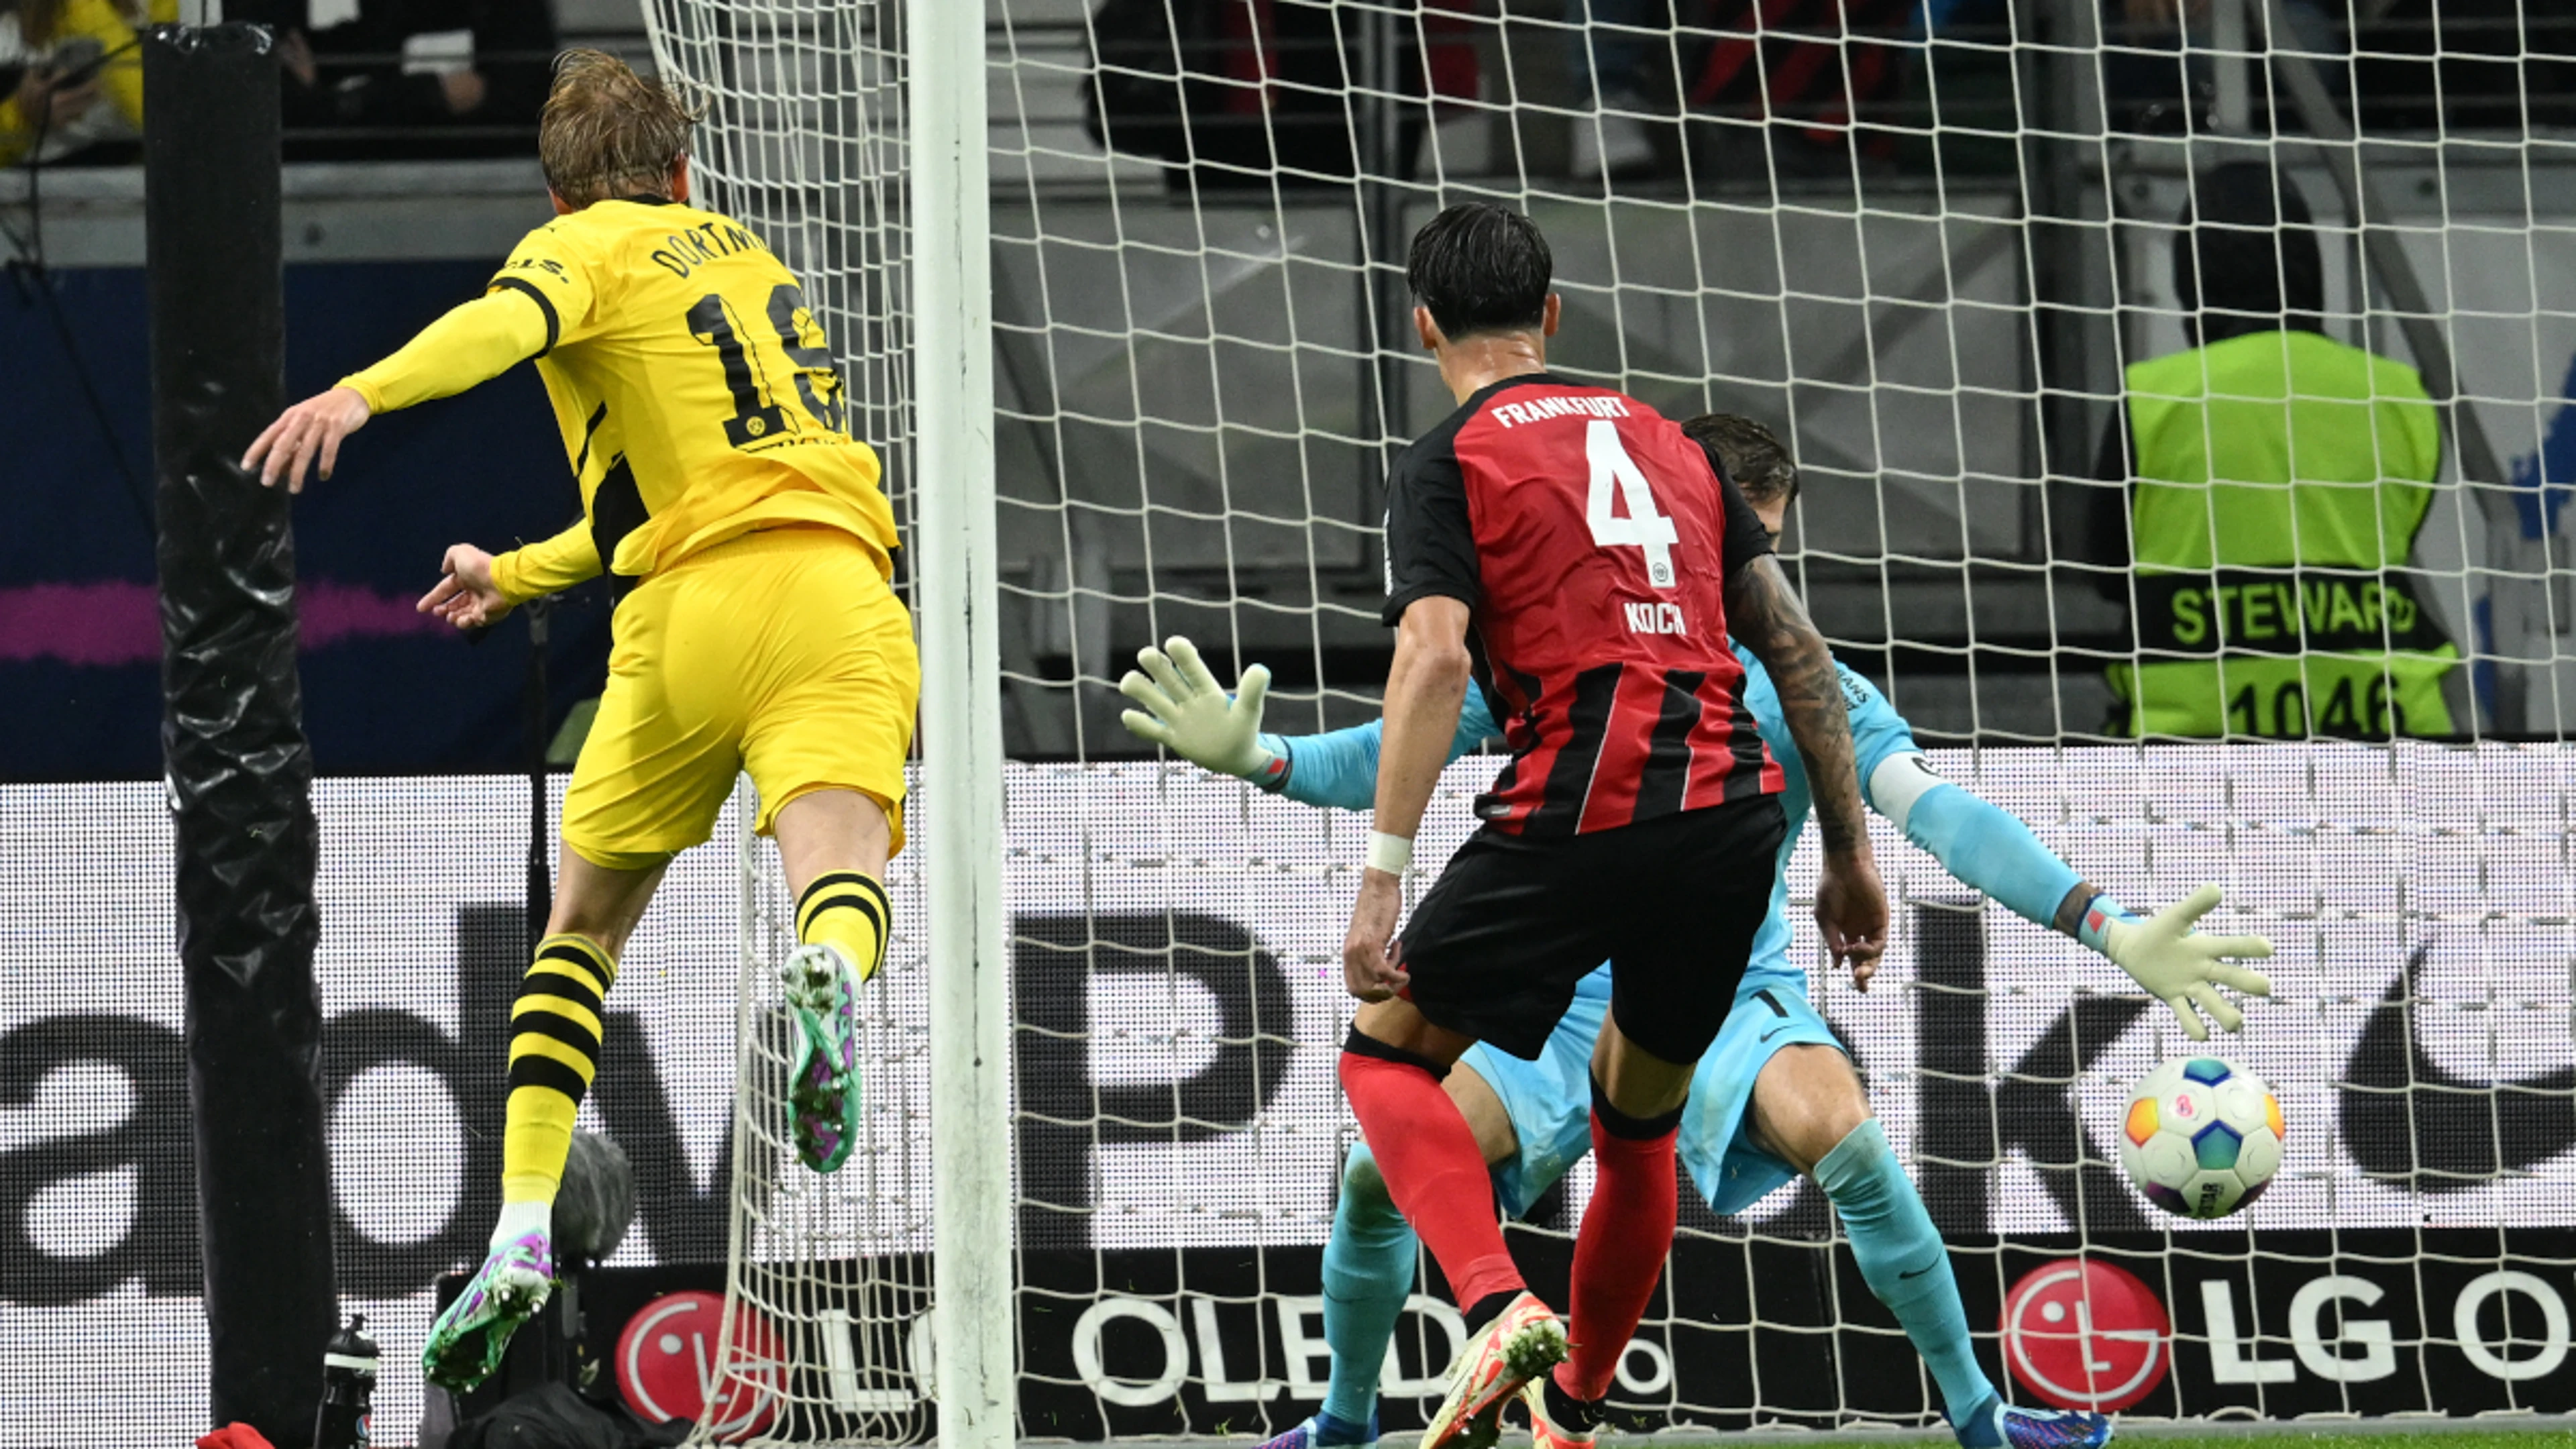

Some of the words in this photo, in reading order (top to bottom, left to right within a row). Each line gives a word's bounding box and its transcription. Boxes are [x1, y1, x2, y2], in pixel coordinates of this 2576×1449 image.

[651, 222, 771, 279] DORTM
[1490, 396, 1631, 429] FRANKFURT
[1586, 420, 1679, 588] 4
[1624, 602, 1687, 635] KOCH
[2229, 674, 2405, 736] 1046
[1751, 989, 1789, 1018] 1
[1073, 1296, 1468, 1408] OLED
[2200, 1274, 2398, 1384] LG
[2453, 1270, 2576, 1381] O
